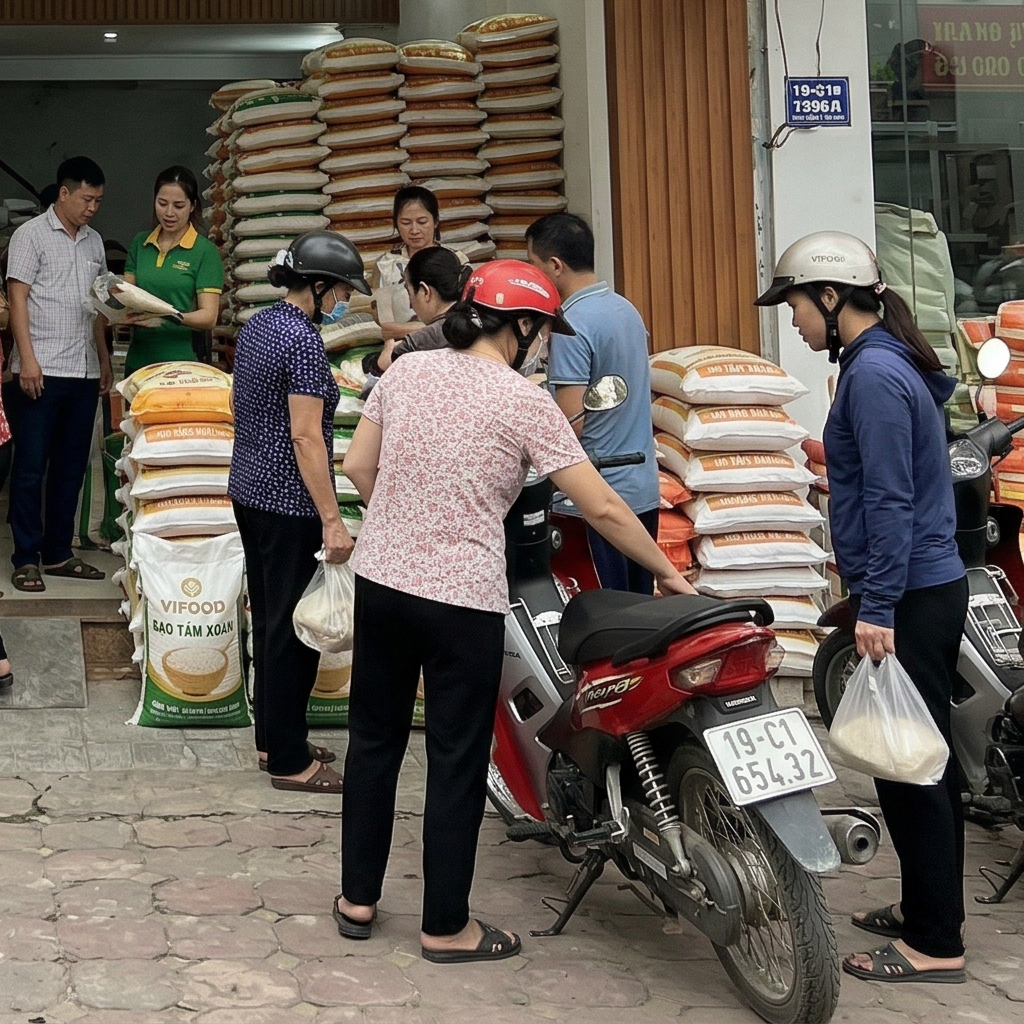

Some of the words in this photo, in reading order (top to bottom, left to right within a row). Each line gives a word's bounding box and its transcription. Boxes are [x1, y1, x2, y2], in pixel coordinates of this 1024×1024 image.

[160, 599, 226, 615] VIFOOD
[206, 620, 234, 637] XOAN
[723, 711, 797, 761] 19-C1
[731, 749, 824, 795] 654.32
